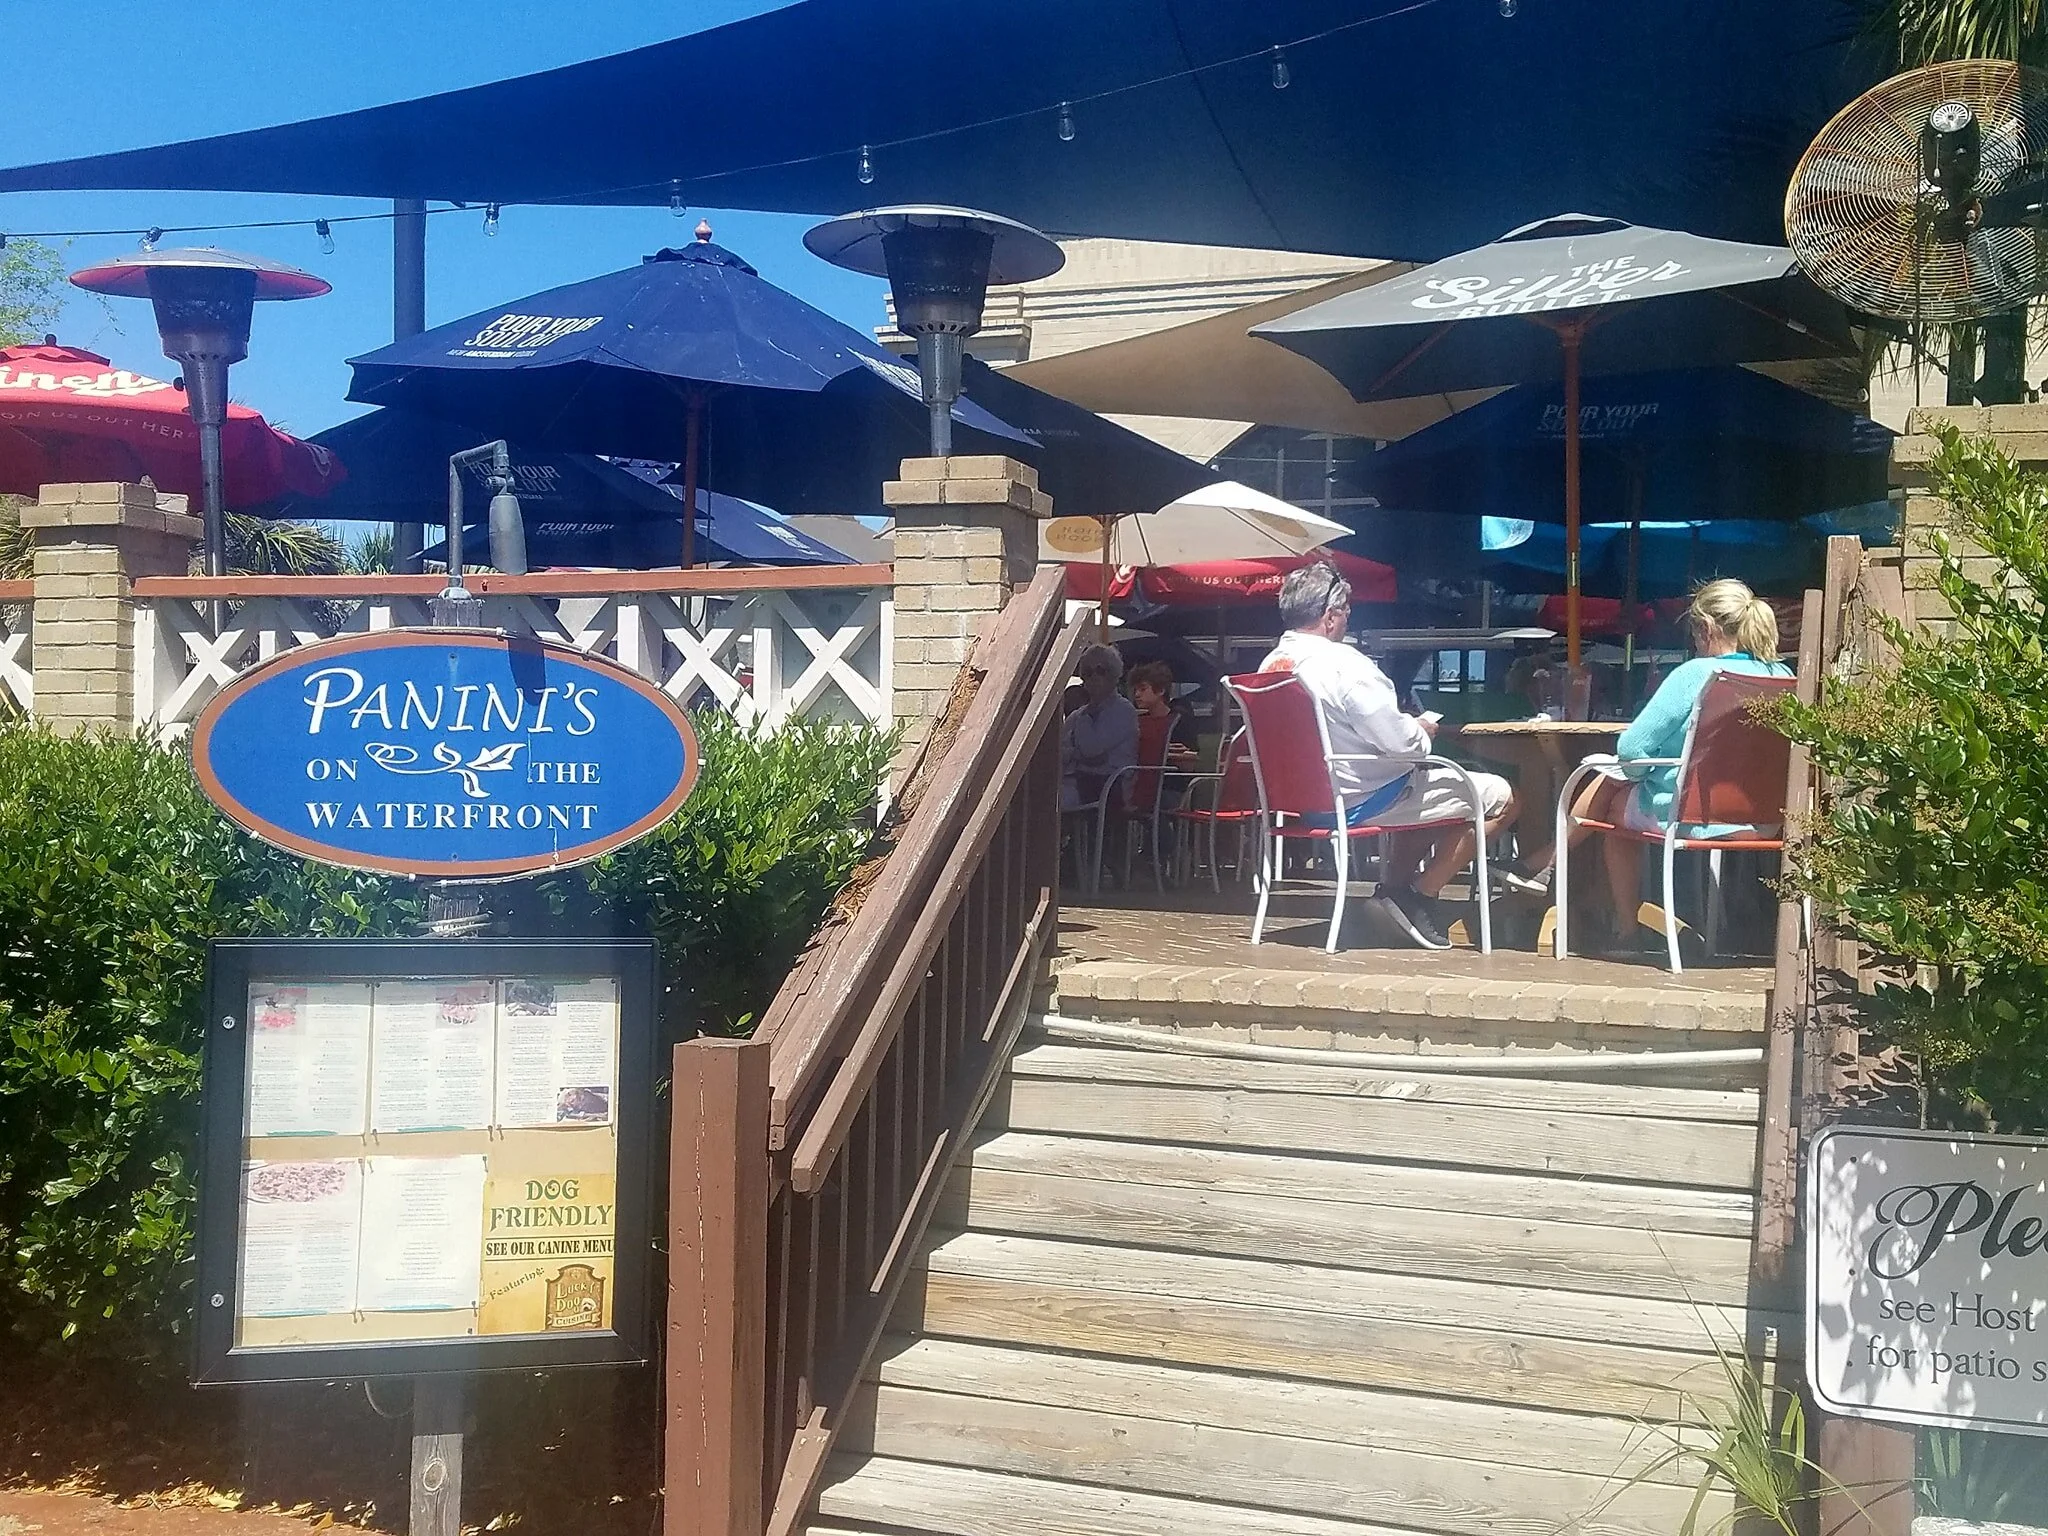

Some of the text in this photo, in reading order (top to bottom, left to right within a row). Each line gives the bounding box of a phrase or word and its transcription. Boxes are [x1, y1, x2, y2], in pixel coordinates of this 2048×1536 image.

[1571, 255, 1636, 275] THE
[1411, 260, 1691, 308] Silver
[486, 313, 604, 335] POUR YOUR
[464, 329, 567, 348] SOUL OUT
[87, 414, 133, 426] OUT
[511, 465, 561, 480] YOUR
[1203, 575, 1220, 585] US
[303, 667, 599, 736] PANINI'S
[305, 758, 601, 785] ON THE
[304, 802, 599, 830] WATERFRONT
[525, 1179, 580, 1201] DOG
[490, 1204, 613, 1233] FRIENDLY
[1868, 1180, 2048, 1280] Ple
[485, 1238, 614, 1257] SEE OUR CANINE MENU
[555, 1297, 581, 1314] Dog
[1879, 1291, 2037, 1333] see Host
[1866, 1334, 1918, 1370] for
[1930, 1349, 2021, 1385] patio
